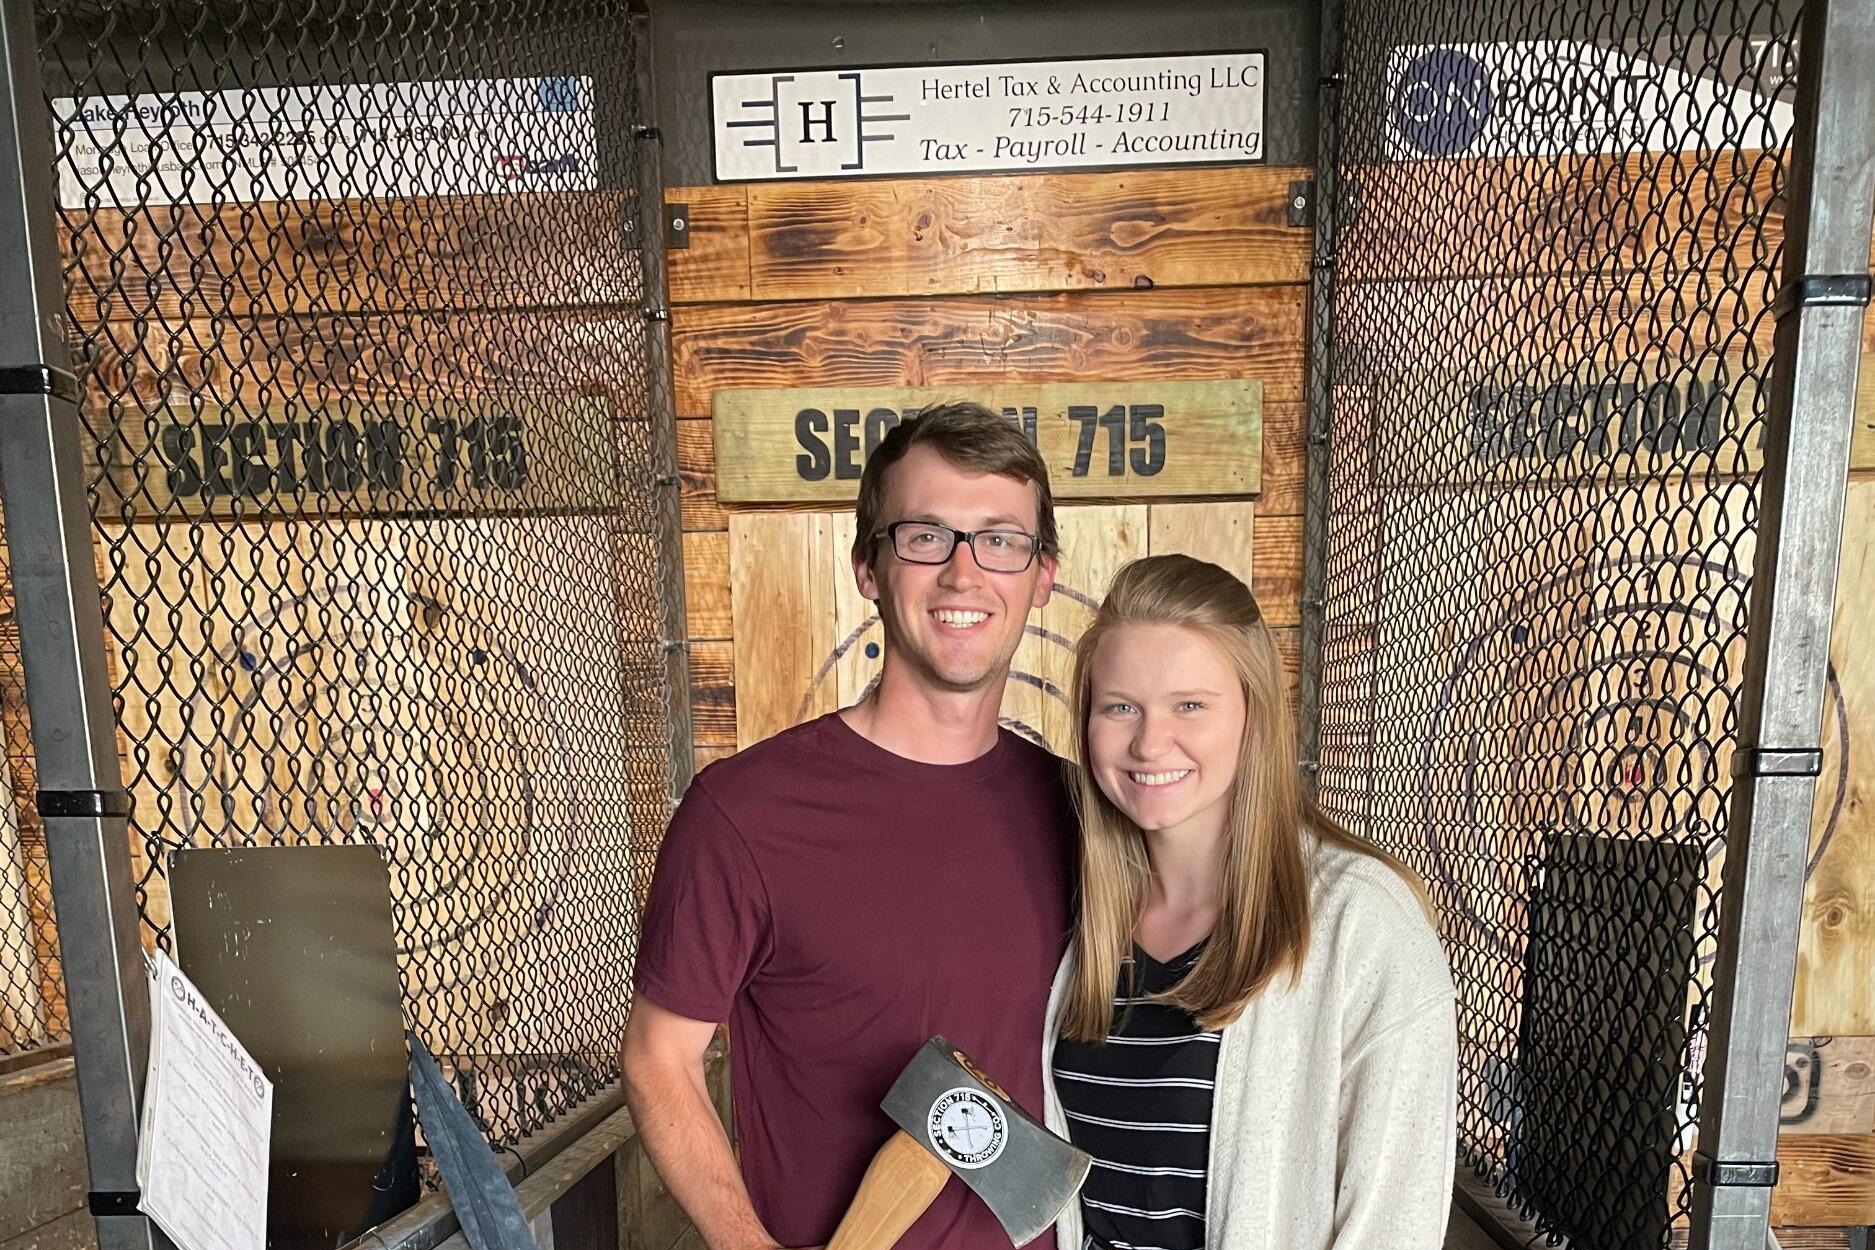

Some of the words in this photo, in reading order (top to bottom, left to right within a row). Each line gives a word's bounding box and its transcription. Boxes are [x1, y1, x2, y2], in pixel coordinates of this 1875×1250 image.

[922, 77, 990, 100] Hertel
[999, 75, 1039, 97] Tax
[1047, 75, 1062, 95] &
[1071, 69, 1201, 97] Accounting
[1210, 65, 1259, 89] LLC
[797, 101, 838, 143] H
[1009, 101, 1170, 128] 715-544-1911
[130, 140, 158, 153] Loa
[919, 138, 968, 161] Tax
[992, 132, 1087, 164] Payroll
[1110, 128, 1261, 155] Accounting
[162, 419, 403, 497] SECTION
[427, 416, 526, 492] 715
[795, 404, 1038, 481] SECN
[1068, 404, 1166, 477] 715
[187, 991, 254, 1080] H-A-T-C-H-E-T
[933, 1096, 954, 1137] SECTION
[955, 1093, 972, 1102] 715
[964, 1131, 1002, 1162] THROWING
